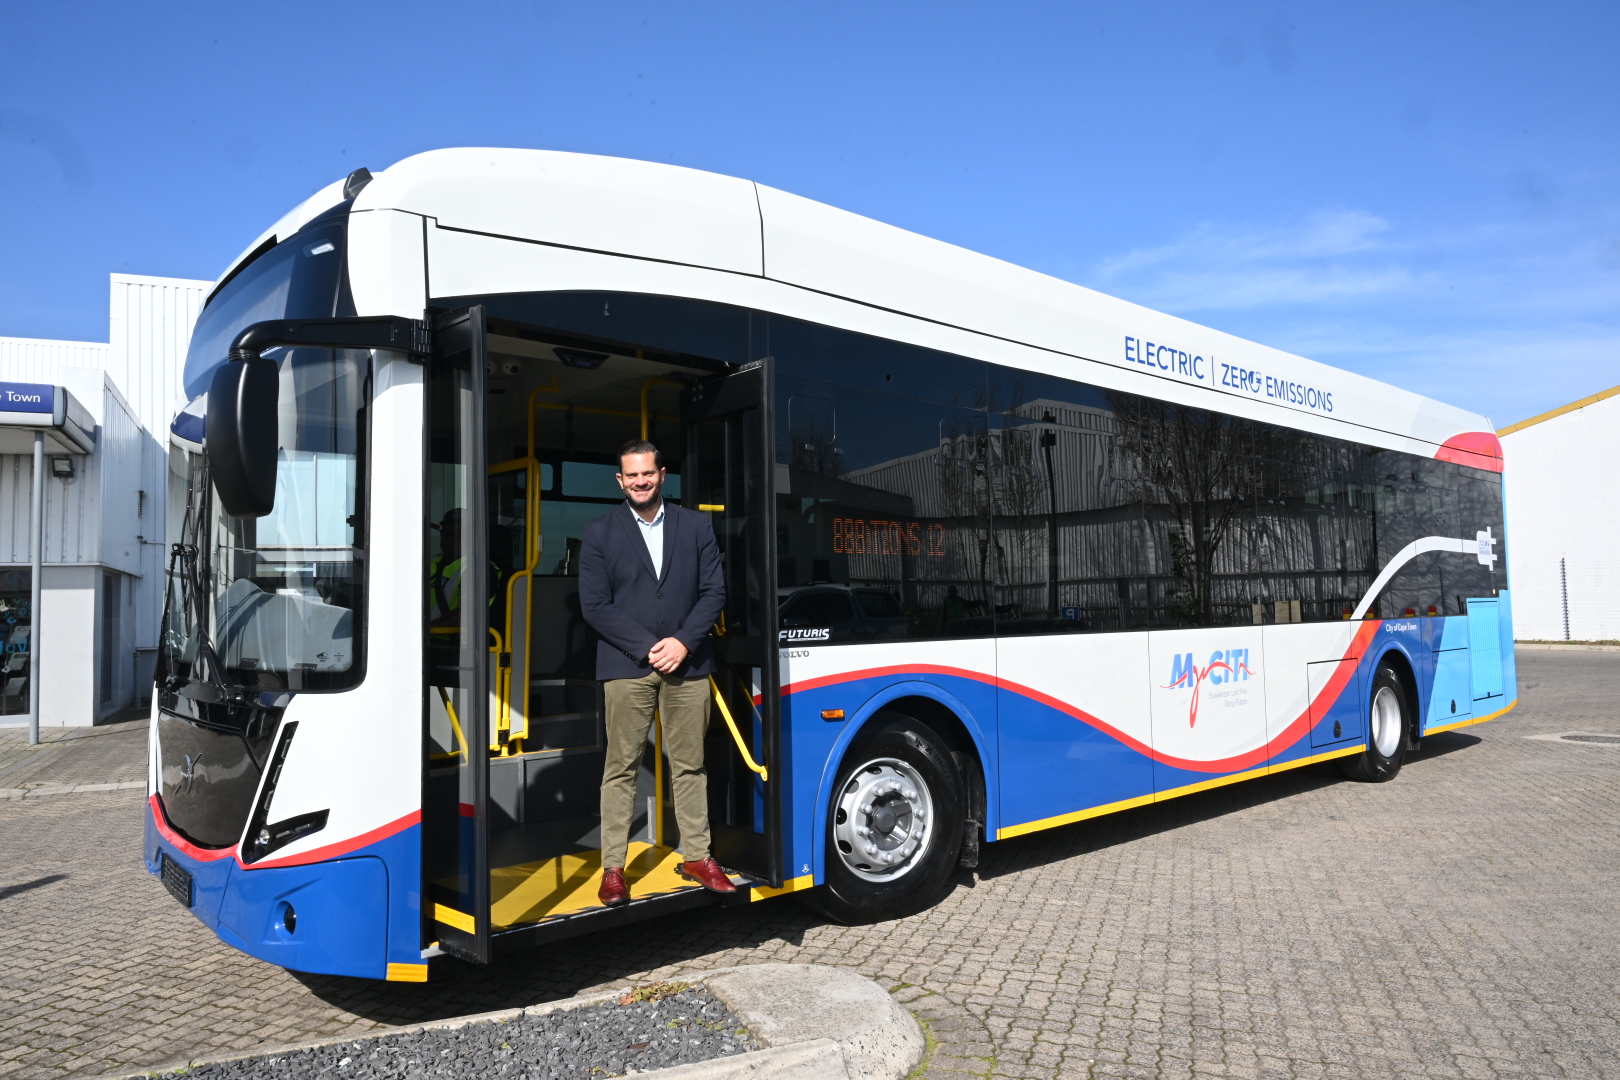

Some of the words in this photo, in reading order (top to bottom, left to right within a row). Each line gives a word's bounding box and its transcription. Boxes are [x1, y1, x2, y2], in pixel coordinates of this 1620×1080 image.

[1124, 335, 1205, 380] ELECTRIC
[1221, 362, 1262, 394] ZERO
[1265, 375, 1334, 413] EMISSIONS
[5, 390, 41, 403] Town
[927, 523, 946, 556] 12
[1393, 622, 1398, 632] of
[1398, 623, 1407, 633] Cape
[1407, 622, 1417, 631] Town
[778, 628, 830, 642] FUTURIS
